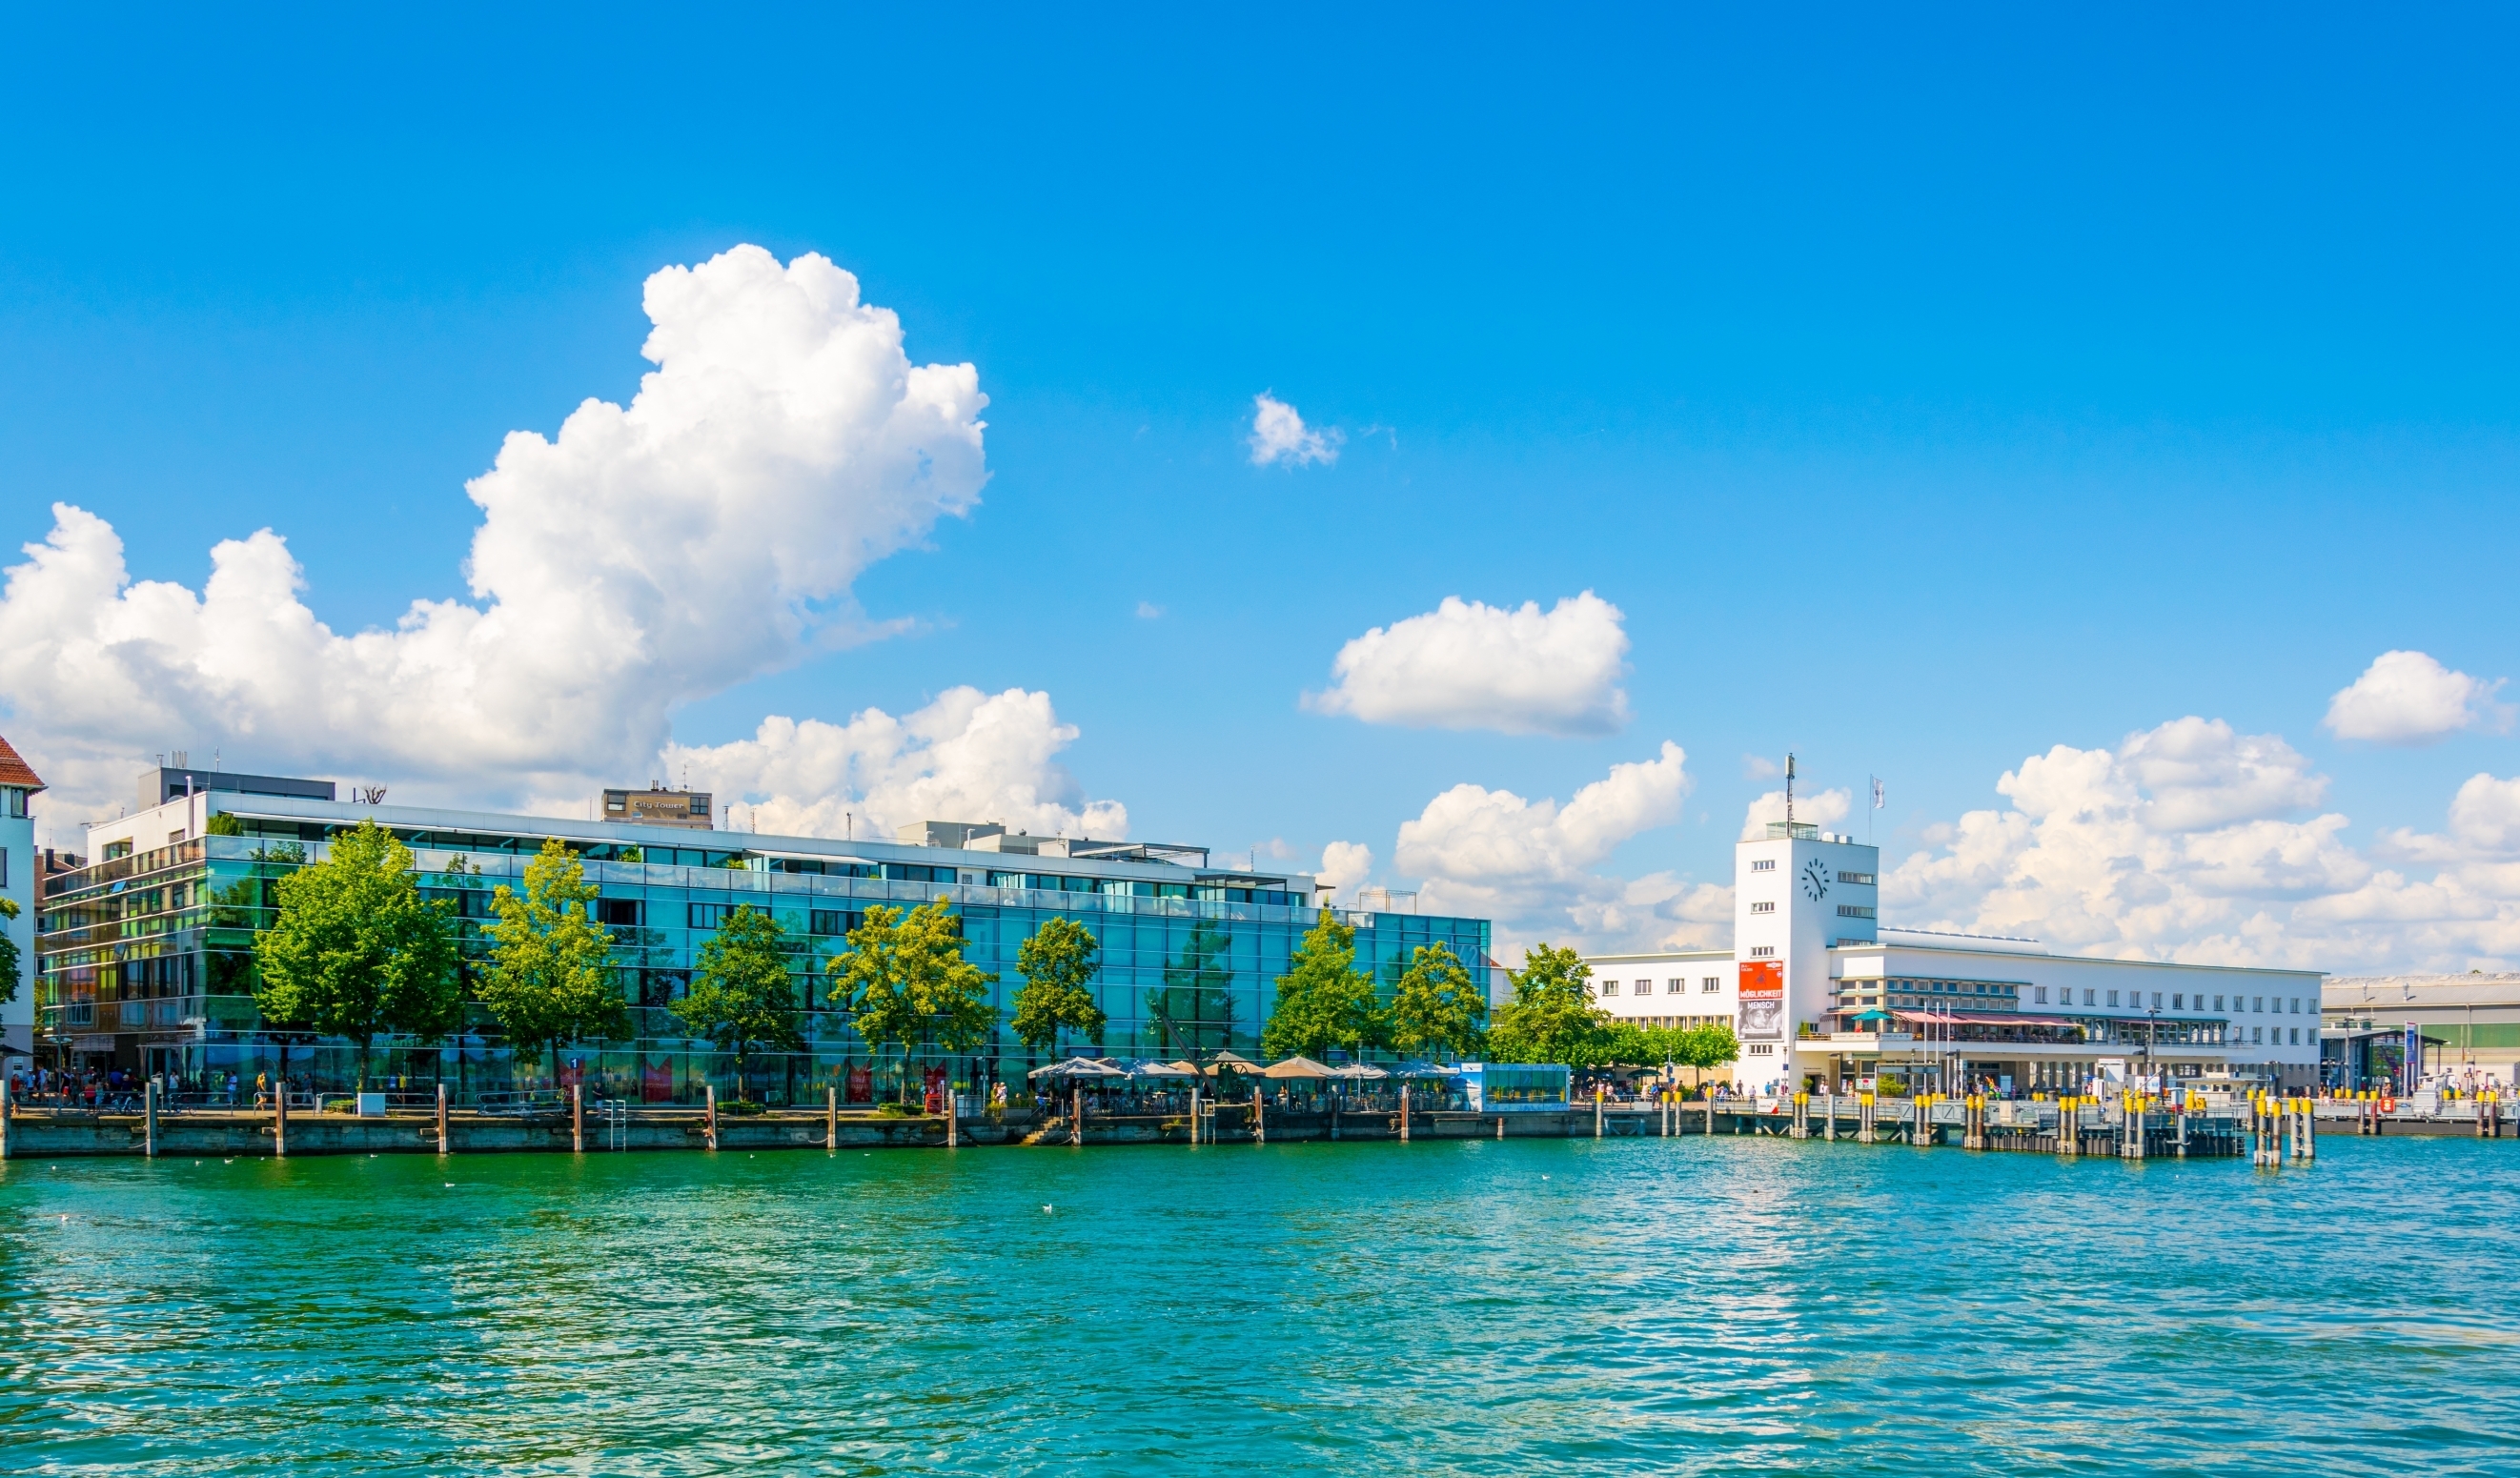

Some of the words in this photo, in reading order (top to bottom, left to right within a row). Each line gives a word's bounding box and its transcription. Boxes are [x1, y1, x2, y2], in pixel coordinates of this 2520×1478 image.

[634, 800, 652, 809] City
[1739, 989, 1782, 998] MÖGLICHKEIT
[571, 1058, 577, 1067] 1
